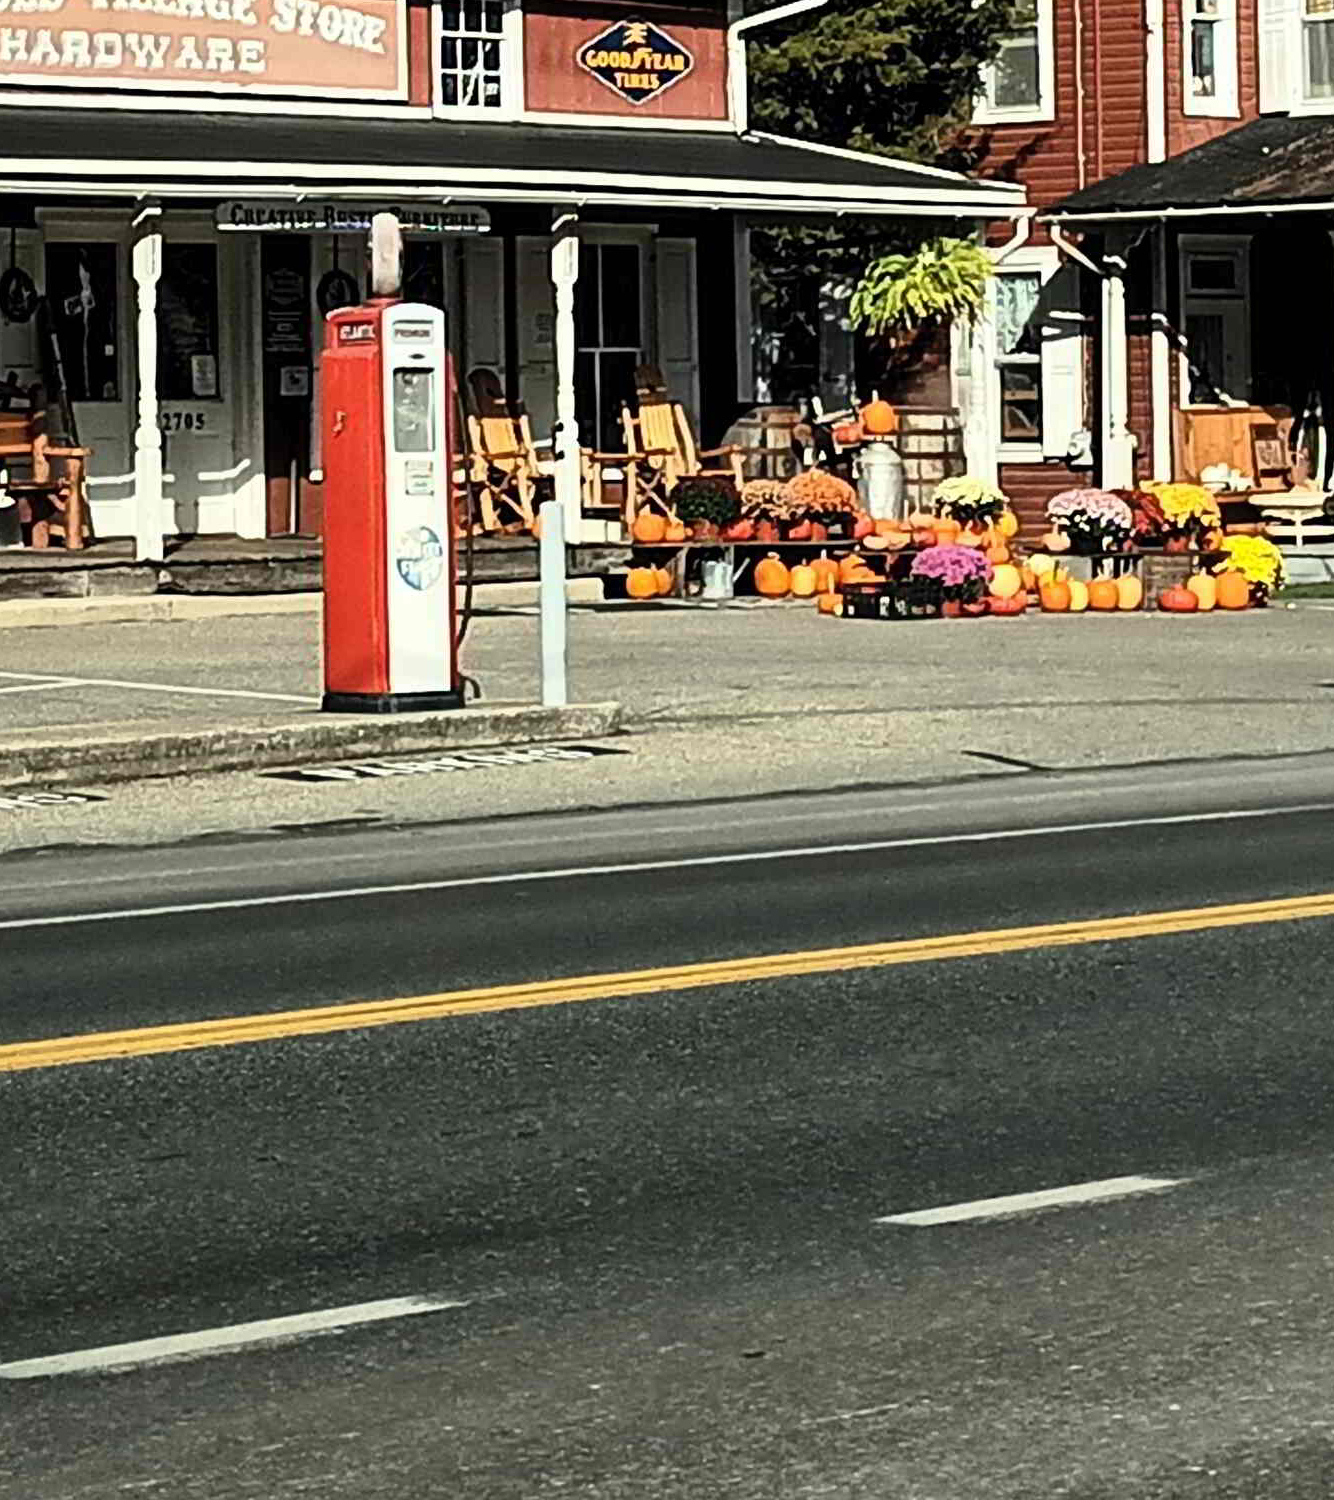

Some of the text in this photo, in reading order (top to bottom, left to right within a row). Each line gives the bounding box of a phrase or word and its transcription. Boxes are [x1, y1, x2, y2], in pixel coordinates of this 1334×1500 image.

[585, 47, 685, 71] GOODYEAR
[613, 72, 660, 89] TIRES
[161, 412, 206, 431] 2705
